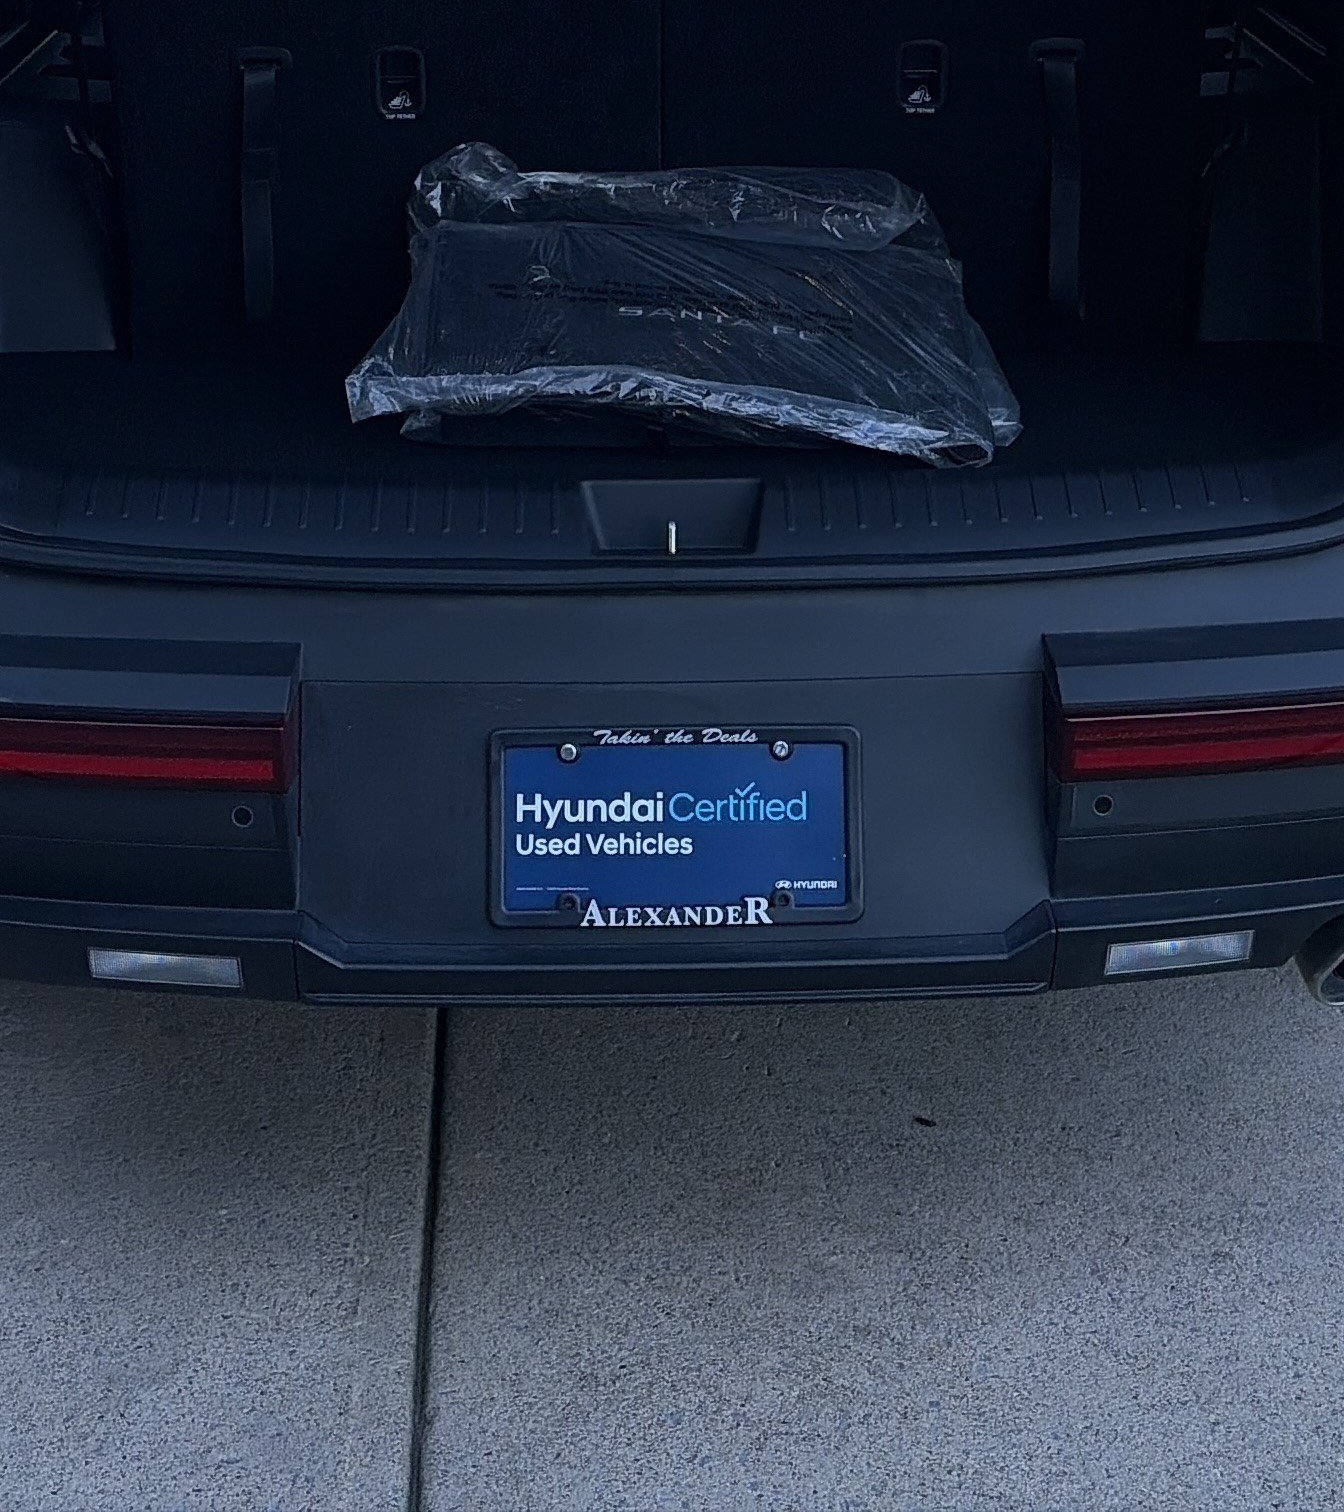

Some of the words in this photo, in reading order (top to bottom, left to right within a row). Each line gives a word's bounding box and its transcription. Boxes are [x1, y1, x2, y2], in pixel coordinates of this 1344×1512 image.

[593, 728, 660, 745] Takin'
[664, 728, 694, 744] the
[701, 727, 759, 743] Deals
[516, 791, 664, 830] Hyundai
[668, 781, 807, 822] Certified
[515, 832, 581, 856] Used
[585, 831, 693, 856] Vehicles
[793, 880, 838, 890] HYUNDAI
[580, 896, 773, 927] ALEXANDER
